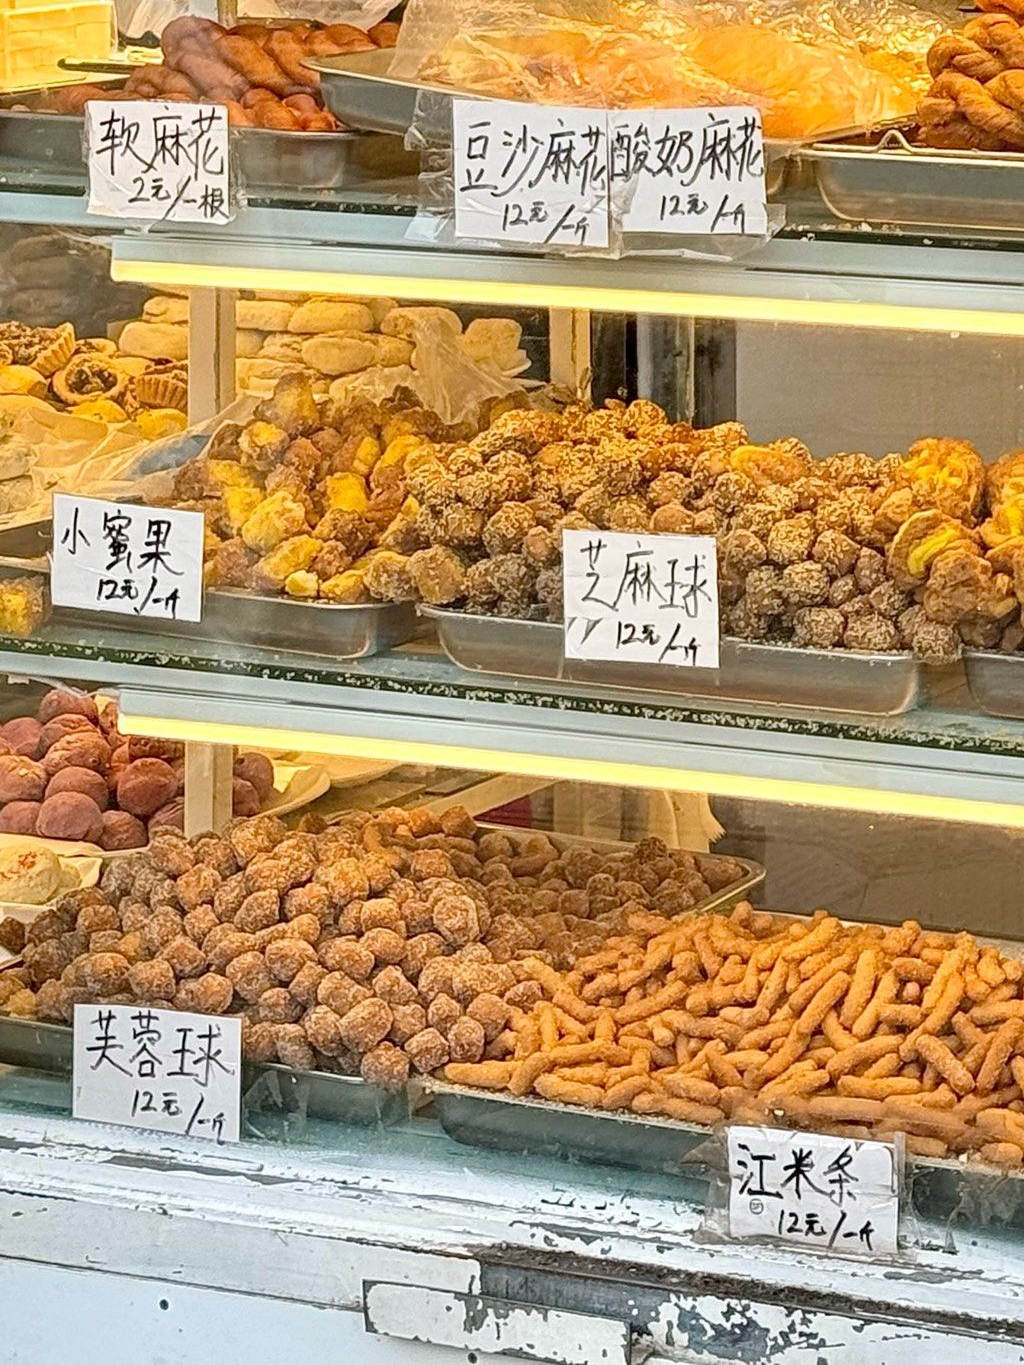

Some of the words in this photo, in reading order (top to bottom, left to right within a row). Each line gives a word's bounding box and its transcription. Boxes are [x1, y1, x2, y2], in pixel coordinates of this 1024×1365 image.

[96, 106, 224, 181] 软麻花
[460, 118, 607, 197] 豆沙麻花
[610, 113, 765, 187] 酸奶麻花
[61, 507, 185, 576] 小蜜果
[580, 538, 712, 618] 芝麻球
[86, 1009, 236, 1087] 芙蓉球
[737, 1143, 859, 1208] 江米条
